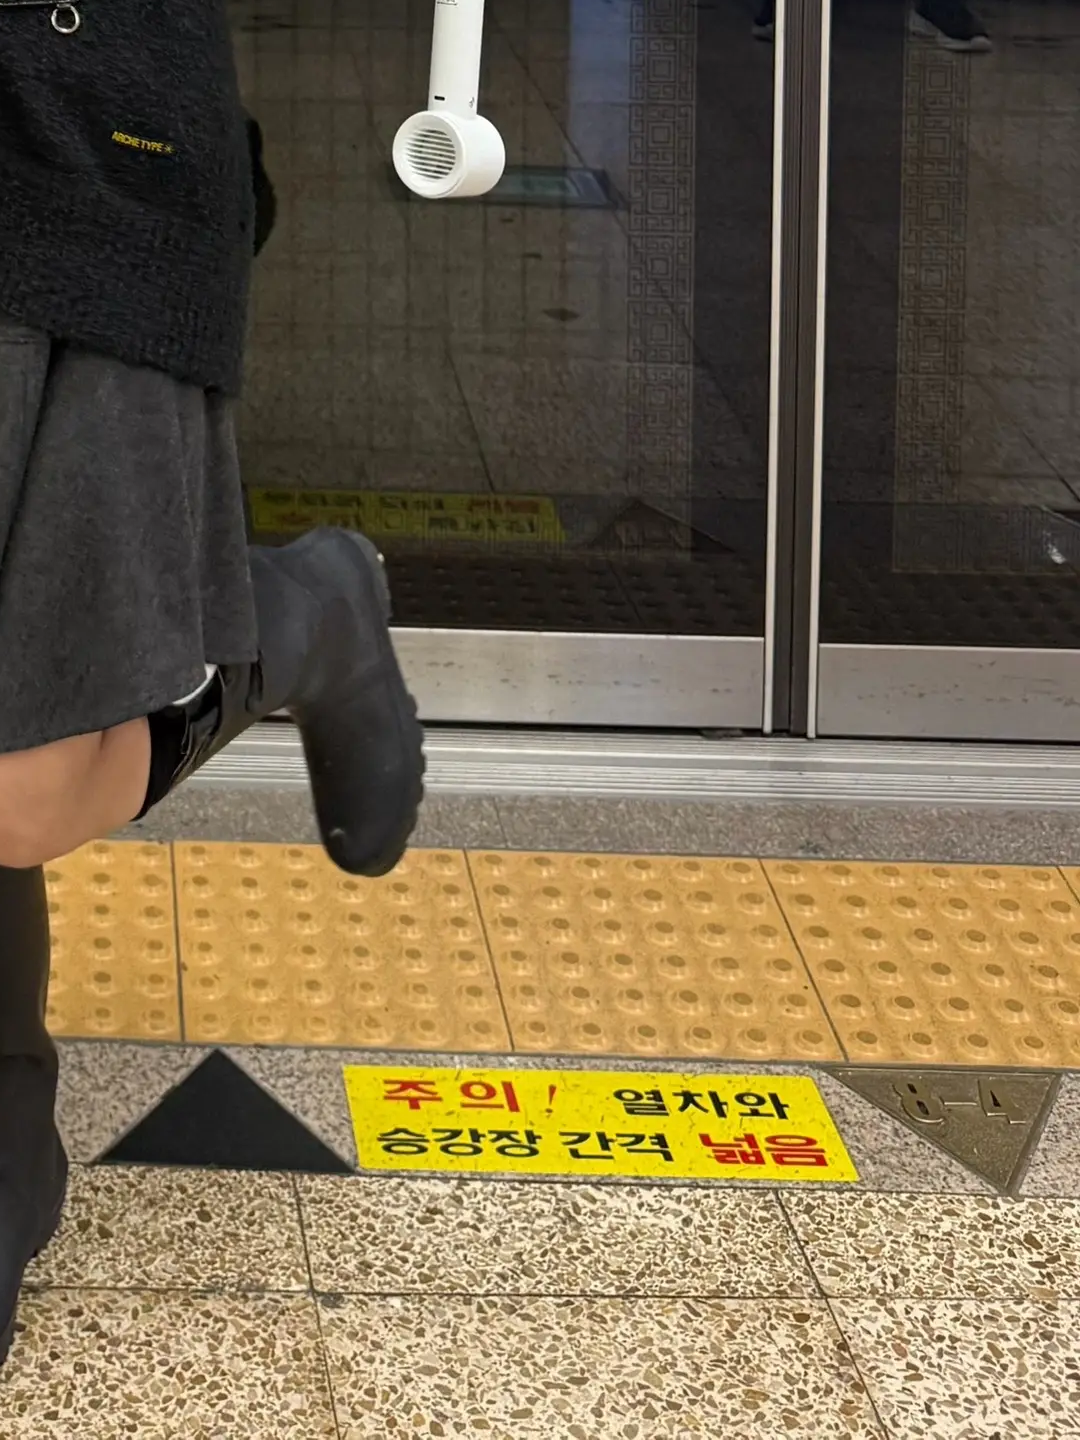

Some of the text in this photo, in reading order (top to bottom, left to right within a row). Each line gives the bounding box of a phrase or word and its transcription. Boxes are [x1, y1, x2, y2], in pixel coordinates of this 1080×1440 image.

[613, 1087, 789, 1120] 열차와
[892, 1078, 1027, 1125] 8-4
[376, 1127, 828, 1167] 승강장 간격 넓음
